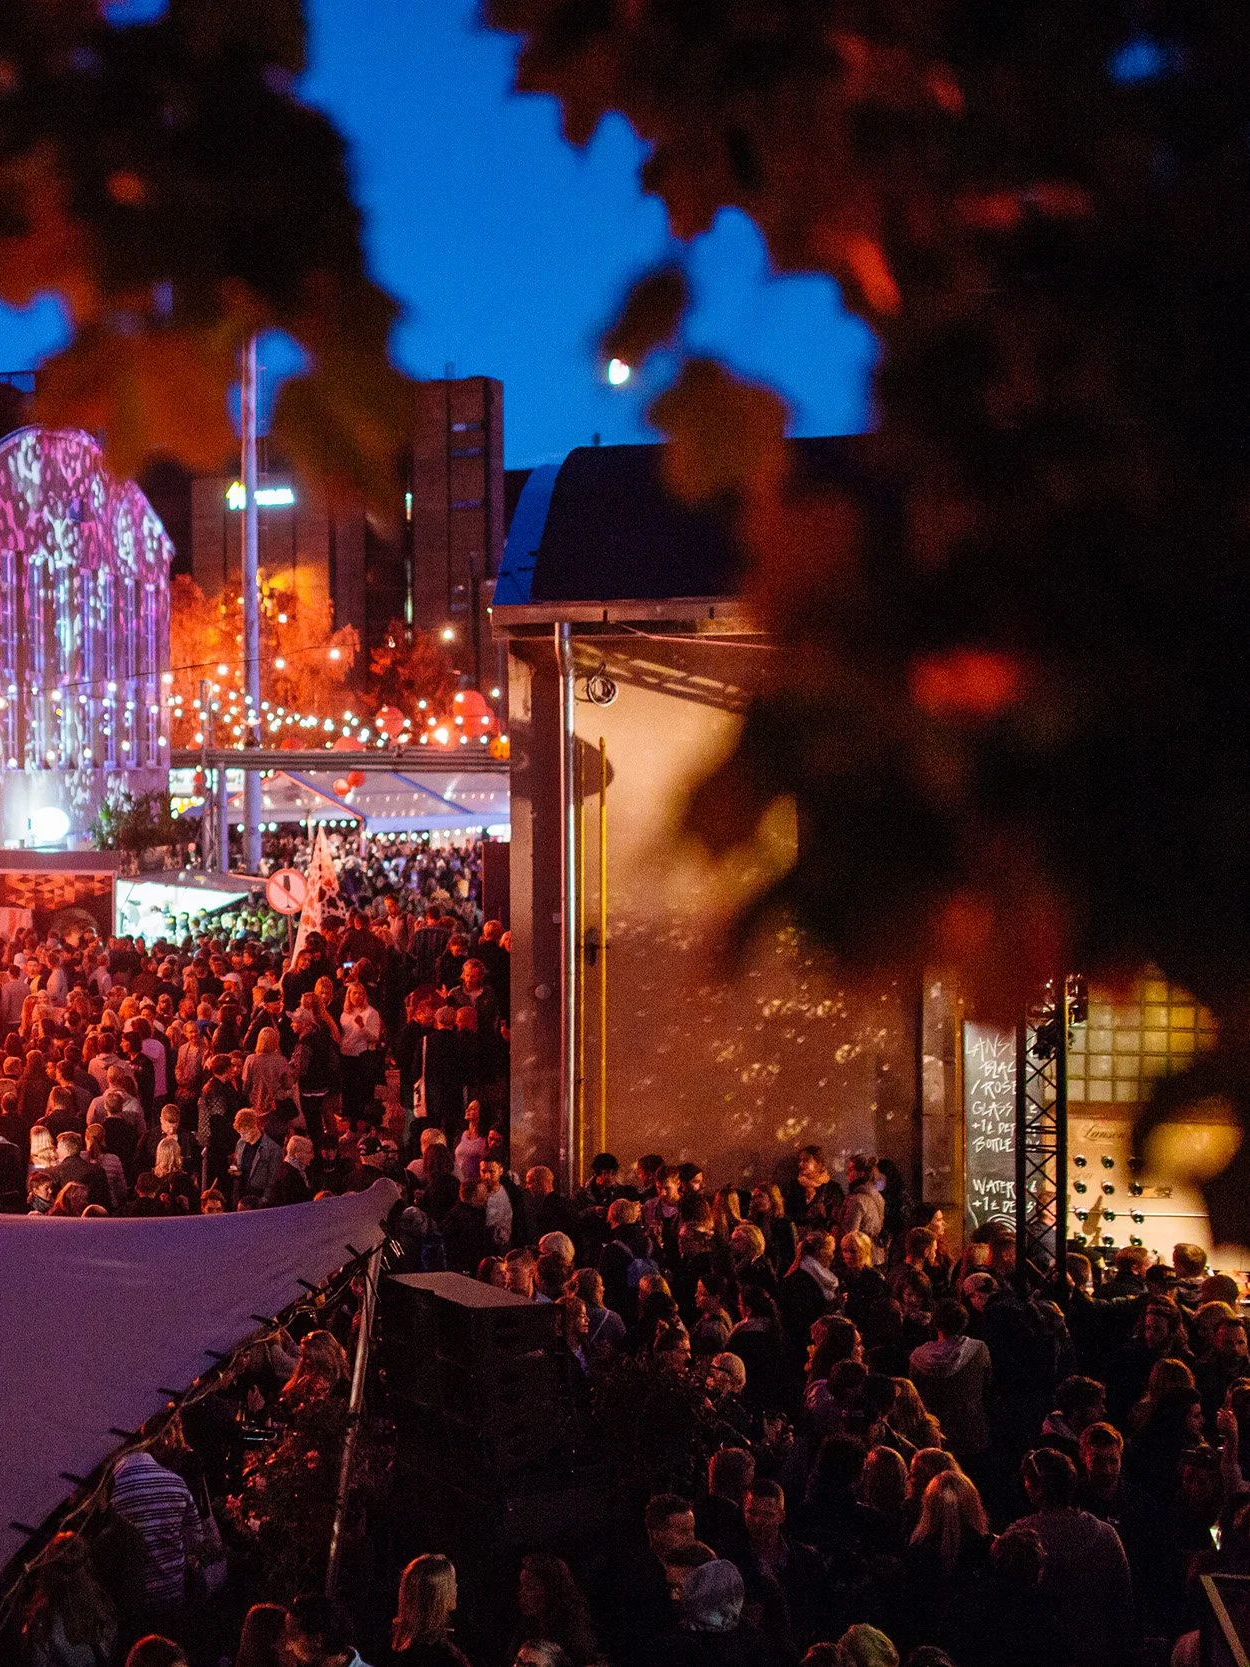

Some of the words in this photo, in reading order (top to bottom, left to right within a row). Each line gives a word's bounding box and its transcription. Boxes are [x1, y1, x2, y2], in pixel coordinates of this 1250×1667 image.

[979, 1060, 1034, 1081] BLAC
[972, 1101, 1014, 1121] GLASS
[972, 1136, 1015, 1153] BOTTLE
[972, 1177, 1017, 1200] WATER
